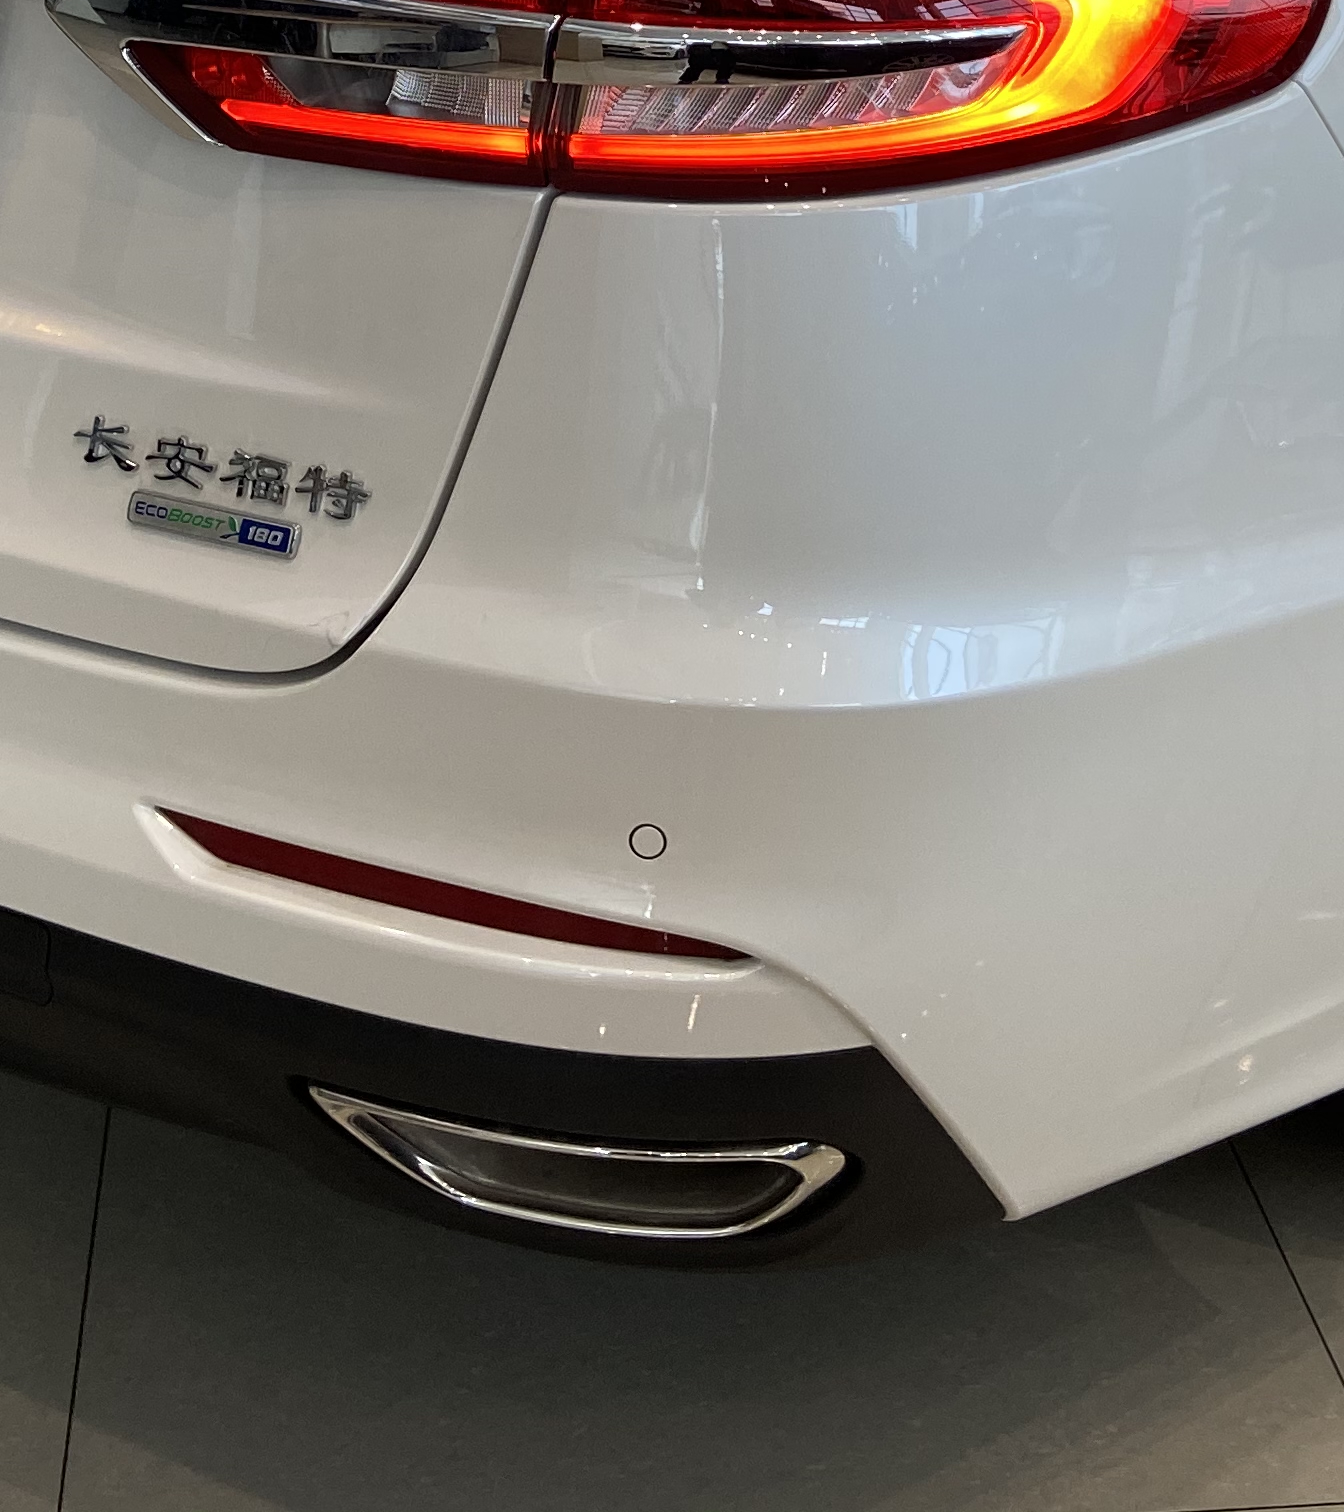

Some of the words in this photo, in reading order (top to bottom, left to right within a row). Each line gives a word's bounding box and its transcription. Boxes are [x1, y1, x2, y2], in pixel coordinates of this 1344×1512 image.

[73, 414, 372, 520] 长安福特
[248, 525, 284, 546] 180
